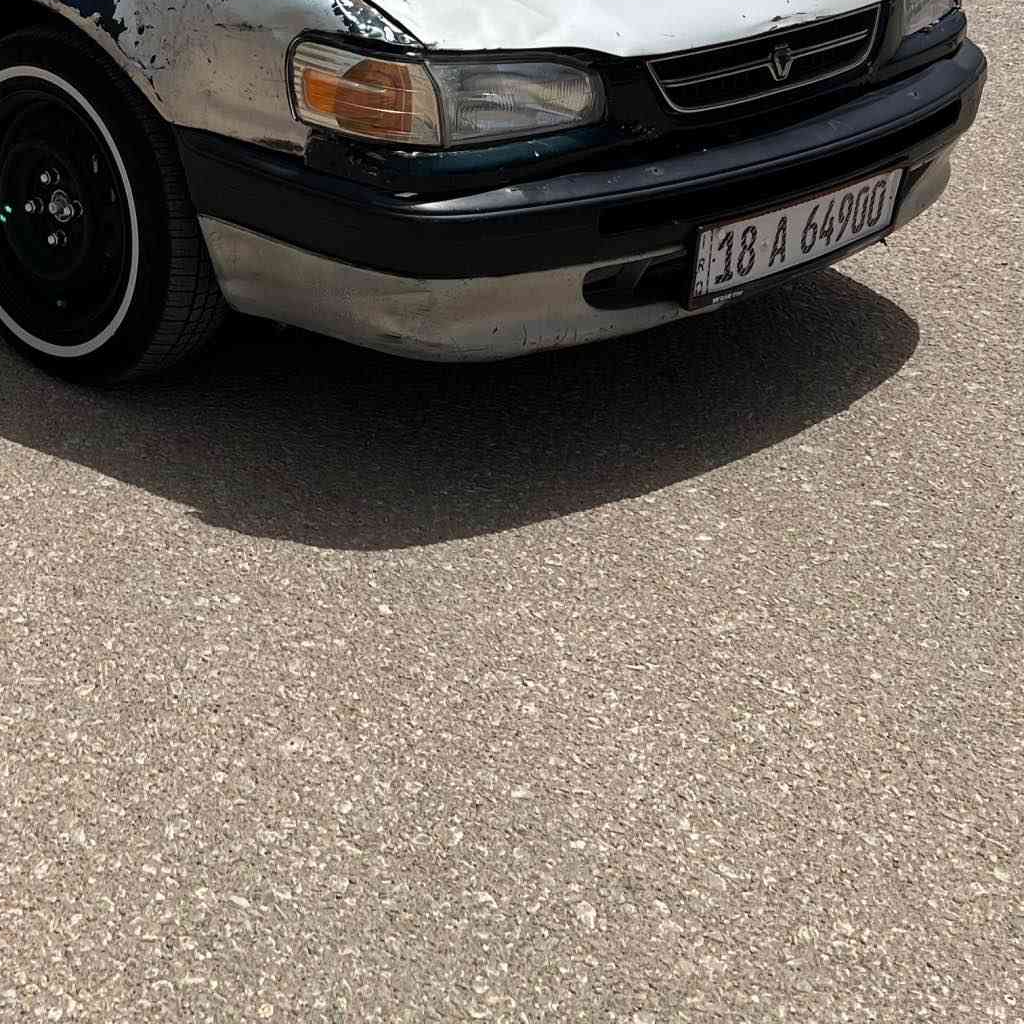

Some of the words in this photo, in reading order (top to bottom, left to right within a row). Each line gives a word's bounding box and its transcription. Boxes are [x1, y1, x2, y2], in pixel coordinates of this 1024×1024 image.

[715, 225, 757, 284] 18
[768, 216, 787, 267] A
[800, 180, 887, 255] 64900
